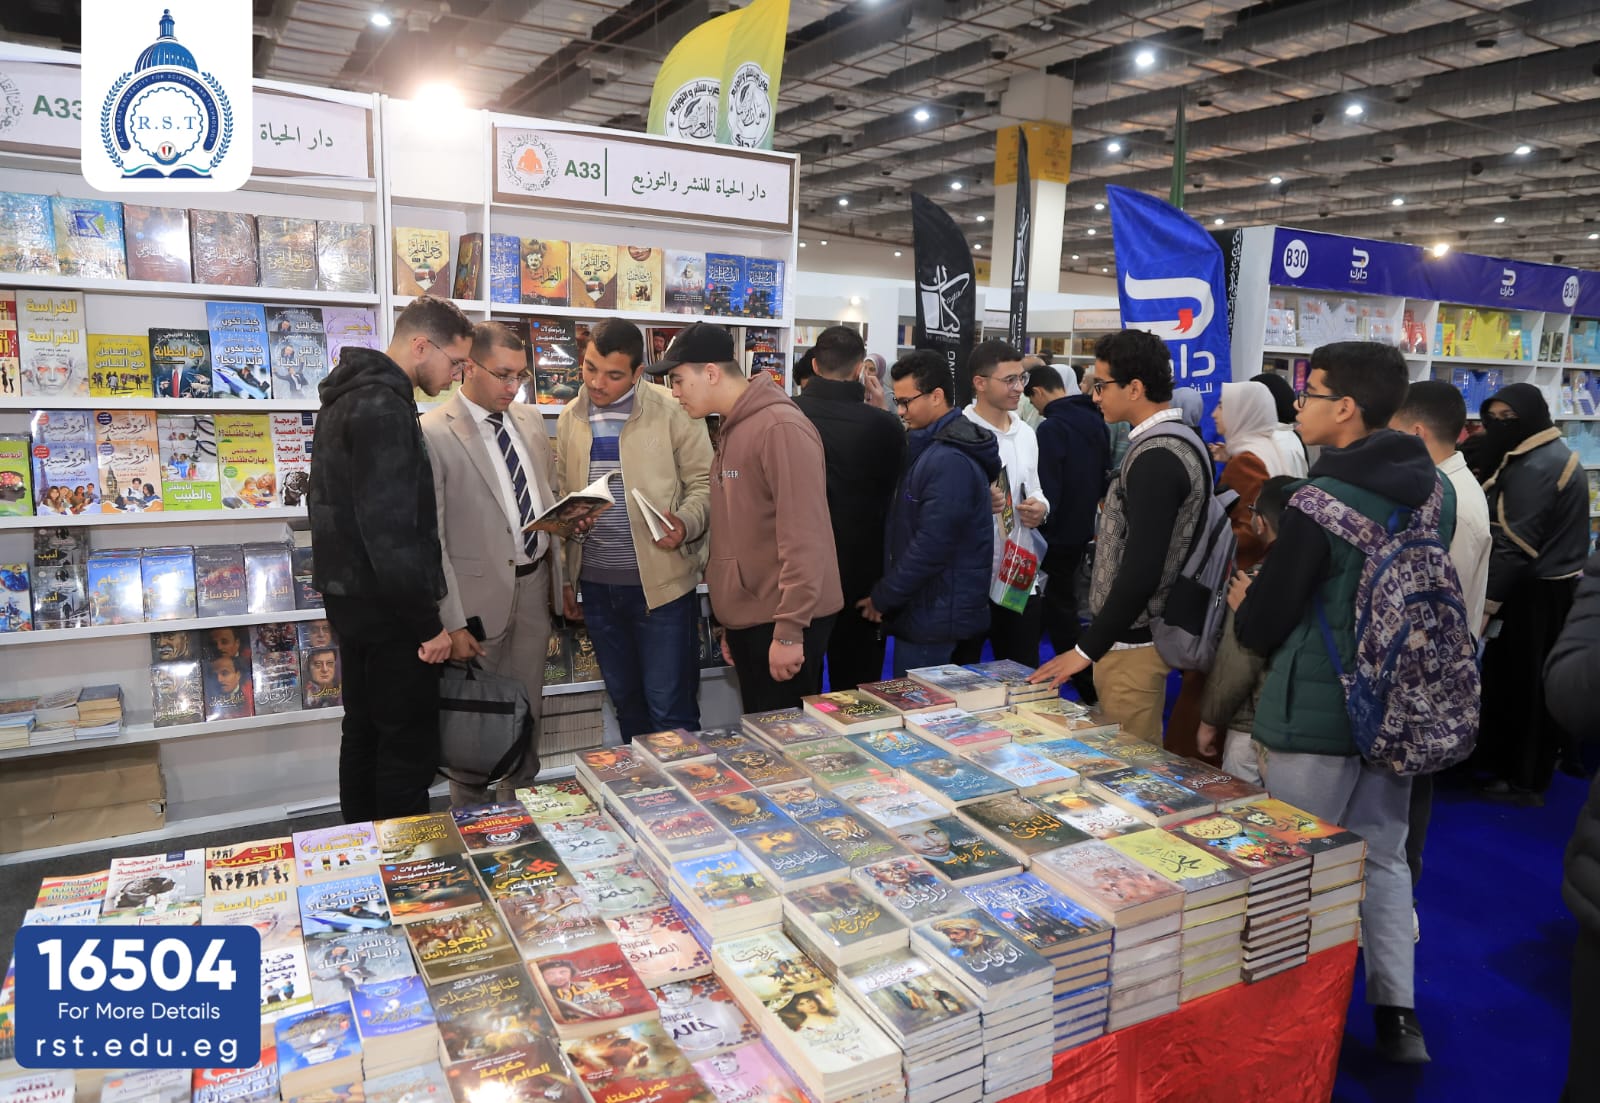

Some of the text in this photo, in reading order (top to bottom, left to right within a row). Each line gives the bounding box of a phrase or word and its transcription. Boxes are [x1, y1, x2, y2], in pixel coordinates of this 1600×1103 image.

[260, 122, 334, 150] دار الحياة
[564, 160, 601, 180] A33
[631, 171, 766, 201] دار الحياة للنشر والتوزيع
[1286, 248, 1307, 269] B30
[26, 299, 78, 316] الفراسة
[27, 328, 79, 346] الفراسة
[97, 347, 142, 358] فن التعامل
[154, 345, 204, 359] فن الخطابة
[224, 345, 262, 354] كيف تكون
[94, 358, 145, 370] مع الناس
[175, 489, 212, 502] والطبيب
[320, 883, 379, 900] كيف تكون
[213, 891, 288, 914] الفراسة
[354, 937, 397, 952] دع القلق
[437, 927, 494, 949] اليهود
[423, 946, 462, 961] إسرائيل
[480, 1060, 550, 1085] حكومة العالم
[649, 1081, 670, 1096] عمر
